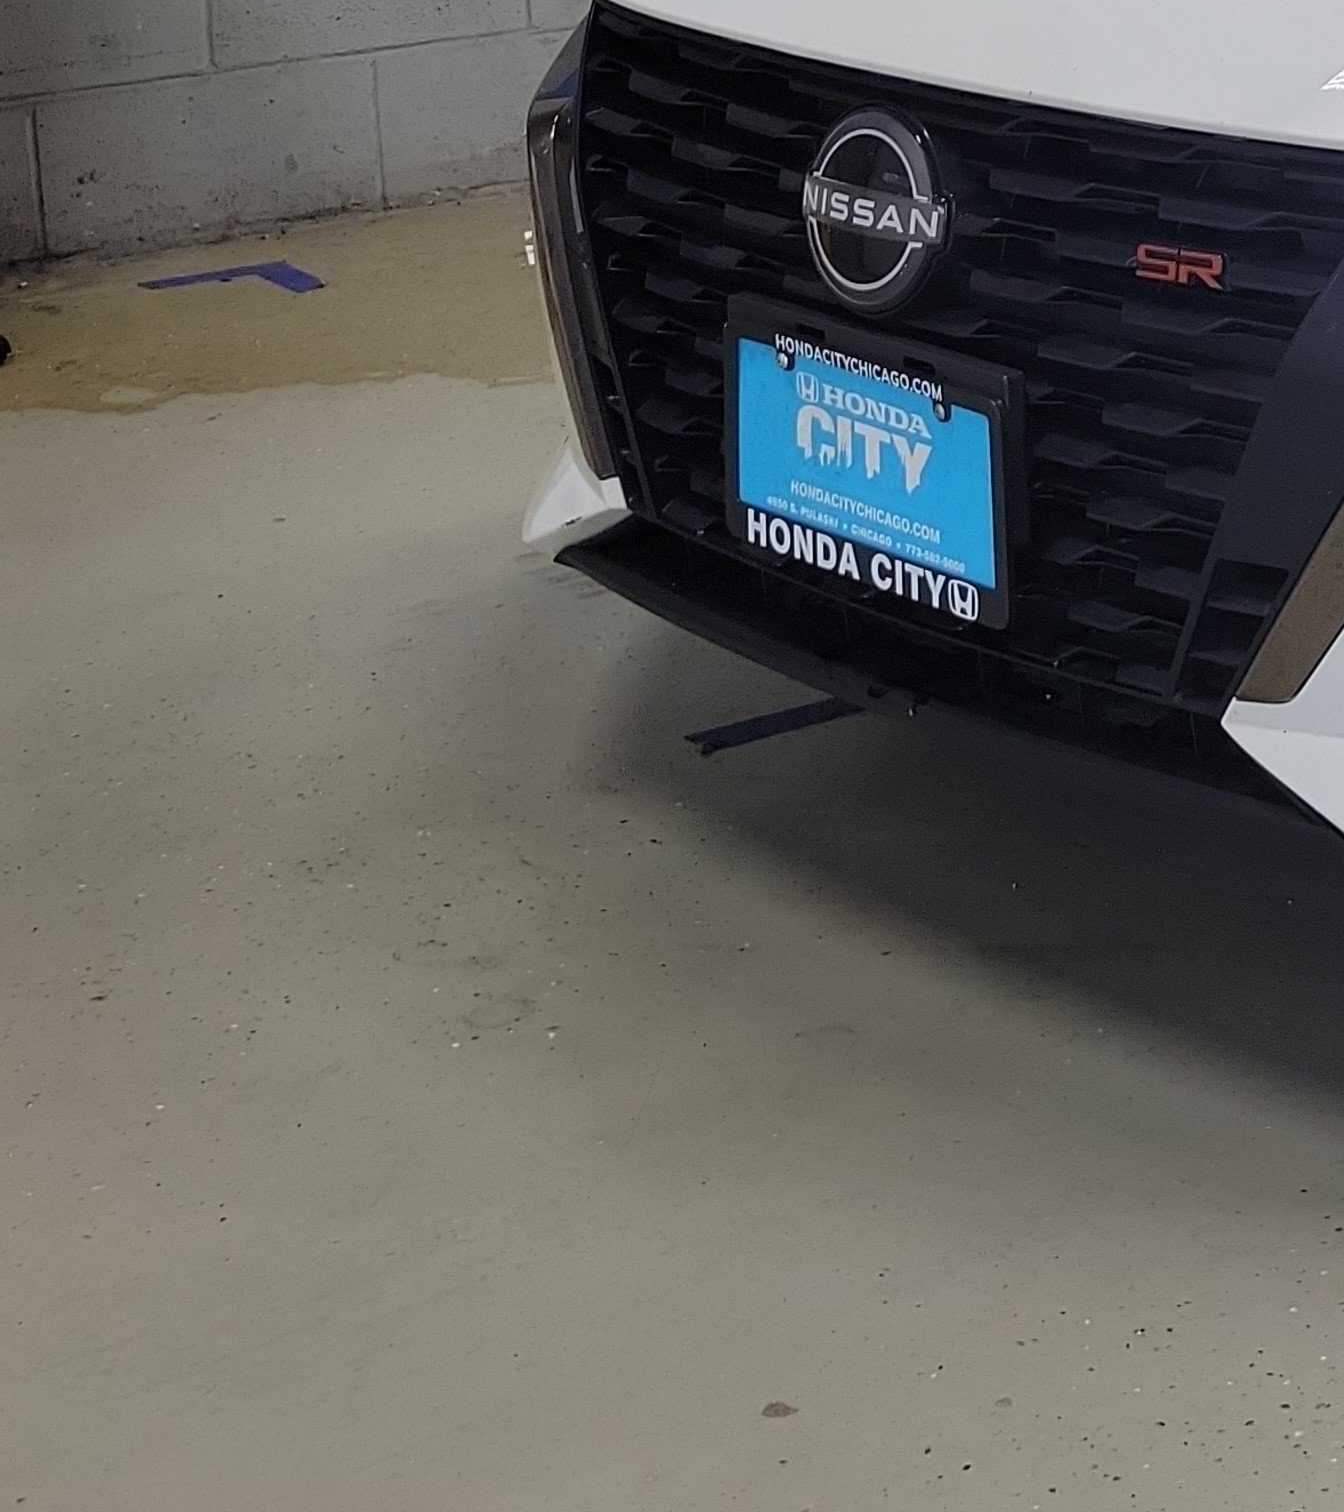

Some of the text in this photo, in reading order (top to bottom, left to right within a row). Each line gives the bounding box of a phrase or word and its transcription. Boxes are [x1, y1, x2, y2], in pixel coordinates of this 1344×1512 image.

[803, 182, 942, 239] NISSAN
[1134, 243, 1225, 290] SR
[774, 332, 943, 403] HONDACITYCHICAGO.COM
[821, 382, 933, 440] HONDA
[795, 403, 933, 495] CITY
[790, 478, 941, 545] HONDACITYCHICAGO.COM
[850, 522, 893, 548] CHICAGO
[747, 507, 950, 610] HONDA CITY
